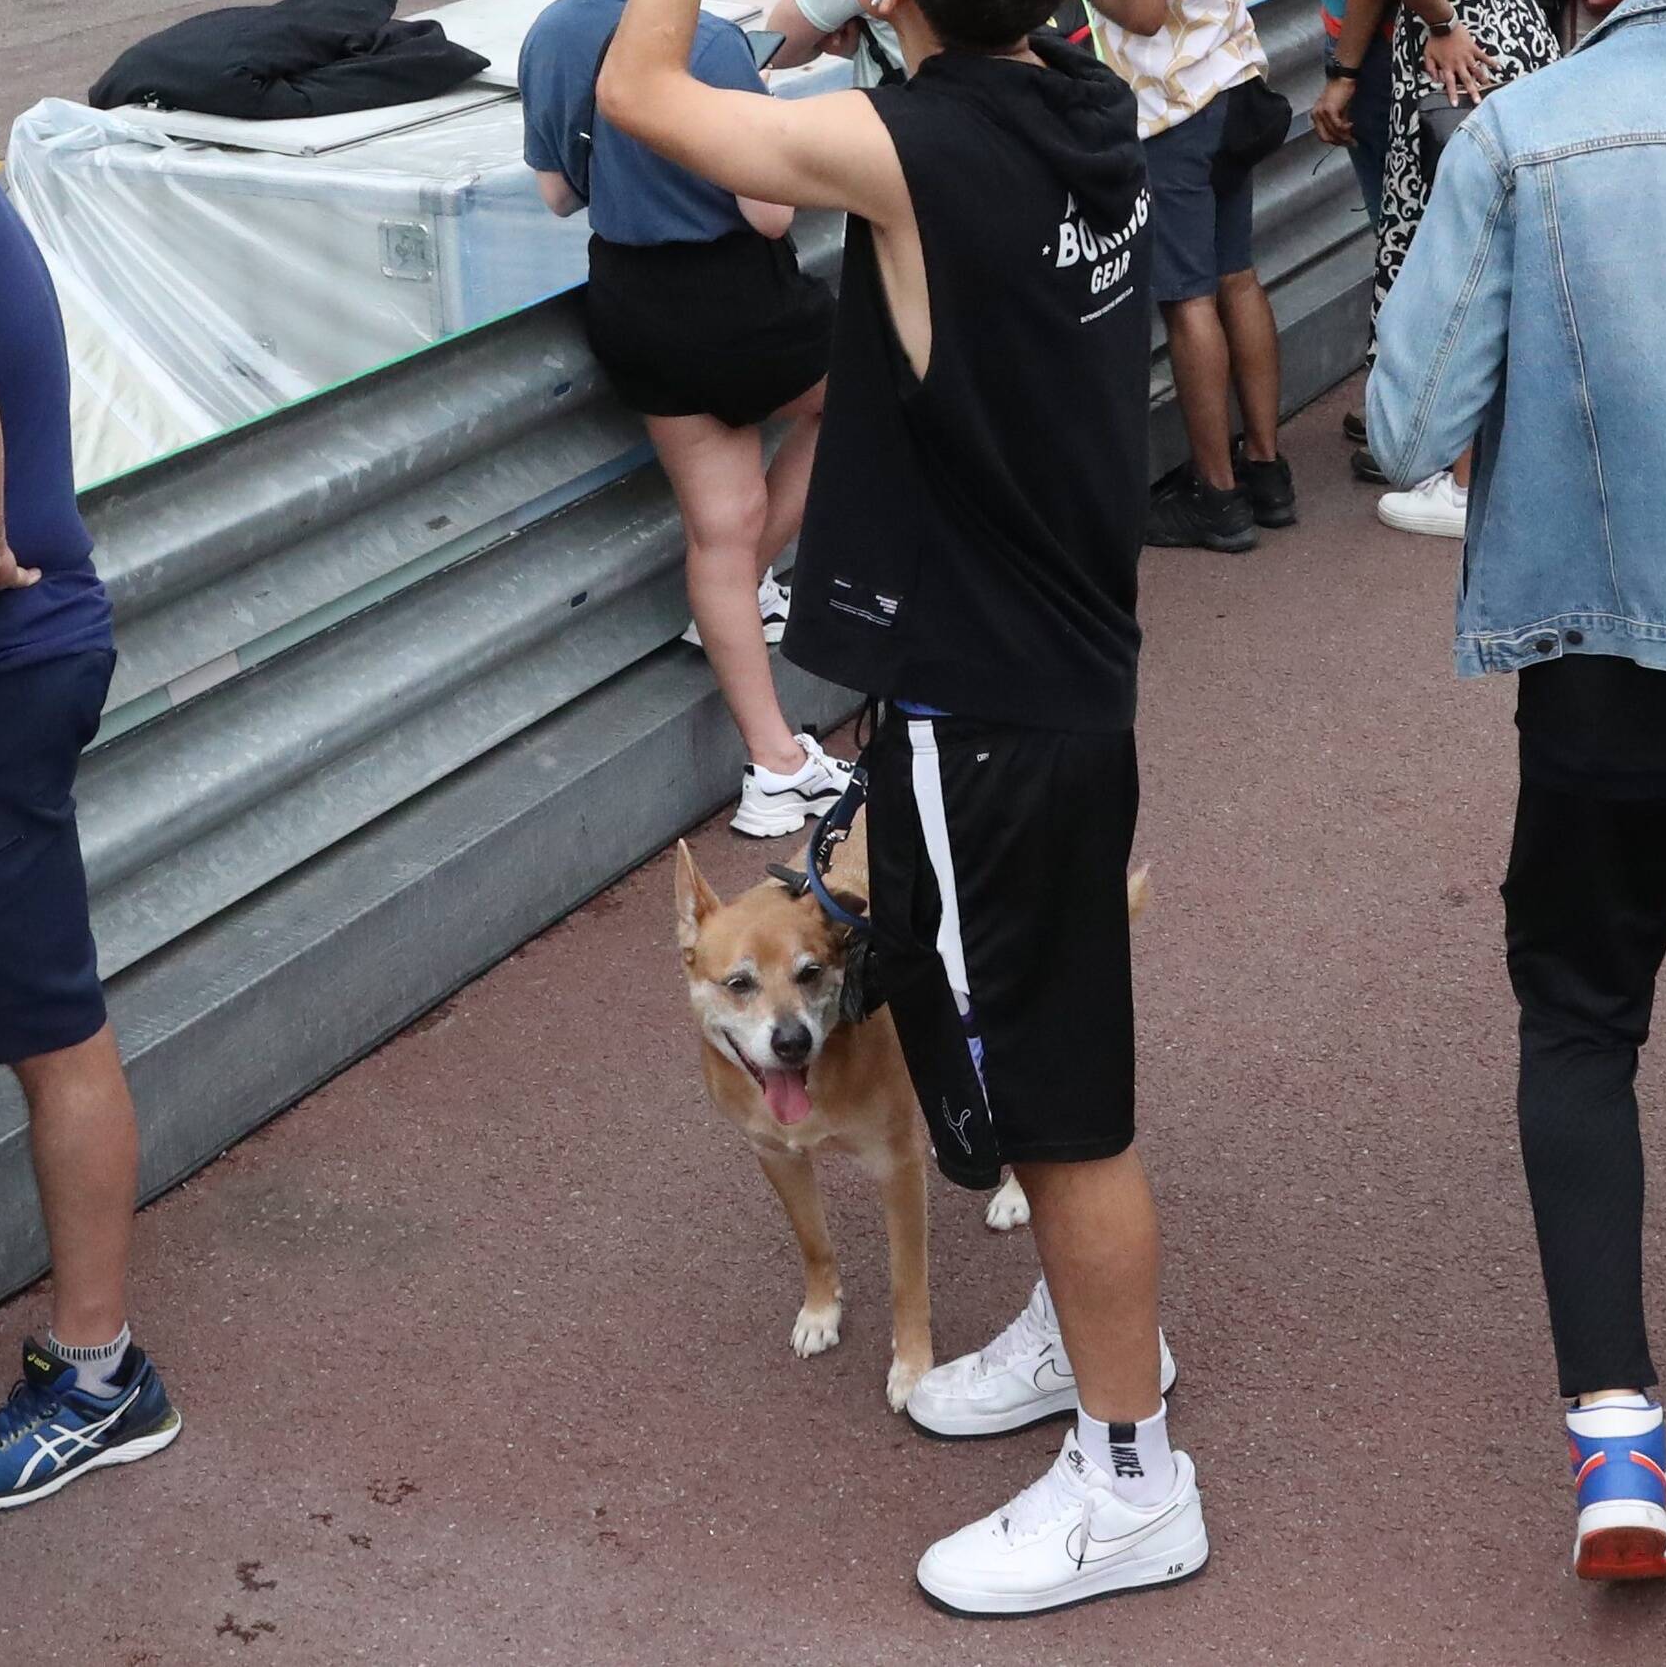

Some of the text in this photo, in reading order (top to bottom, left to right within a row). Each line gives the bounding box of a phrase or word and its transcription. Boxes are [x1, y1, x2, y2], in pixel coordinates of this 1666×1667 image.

[1090, 250, 1131, 294] GEAR
[1110, 1444, 1145, 1478] NIKE
[1167, 1562, 1184, 1576] AIR
